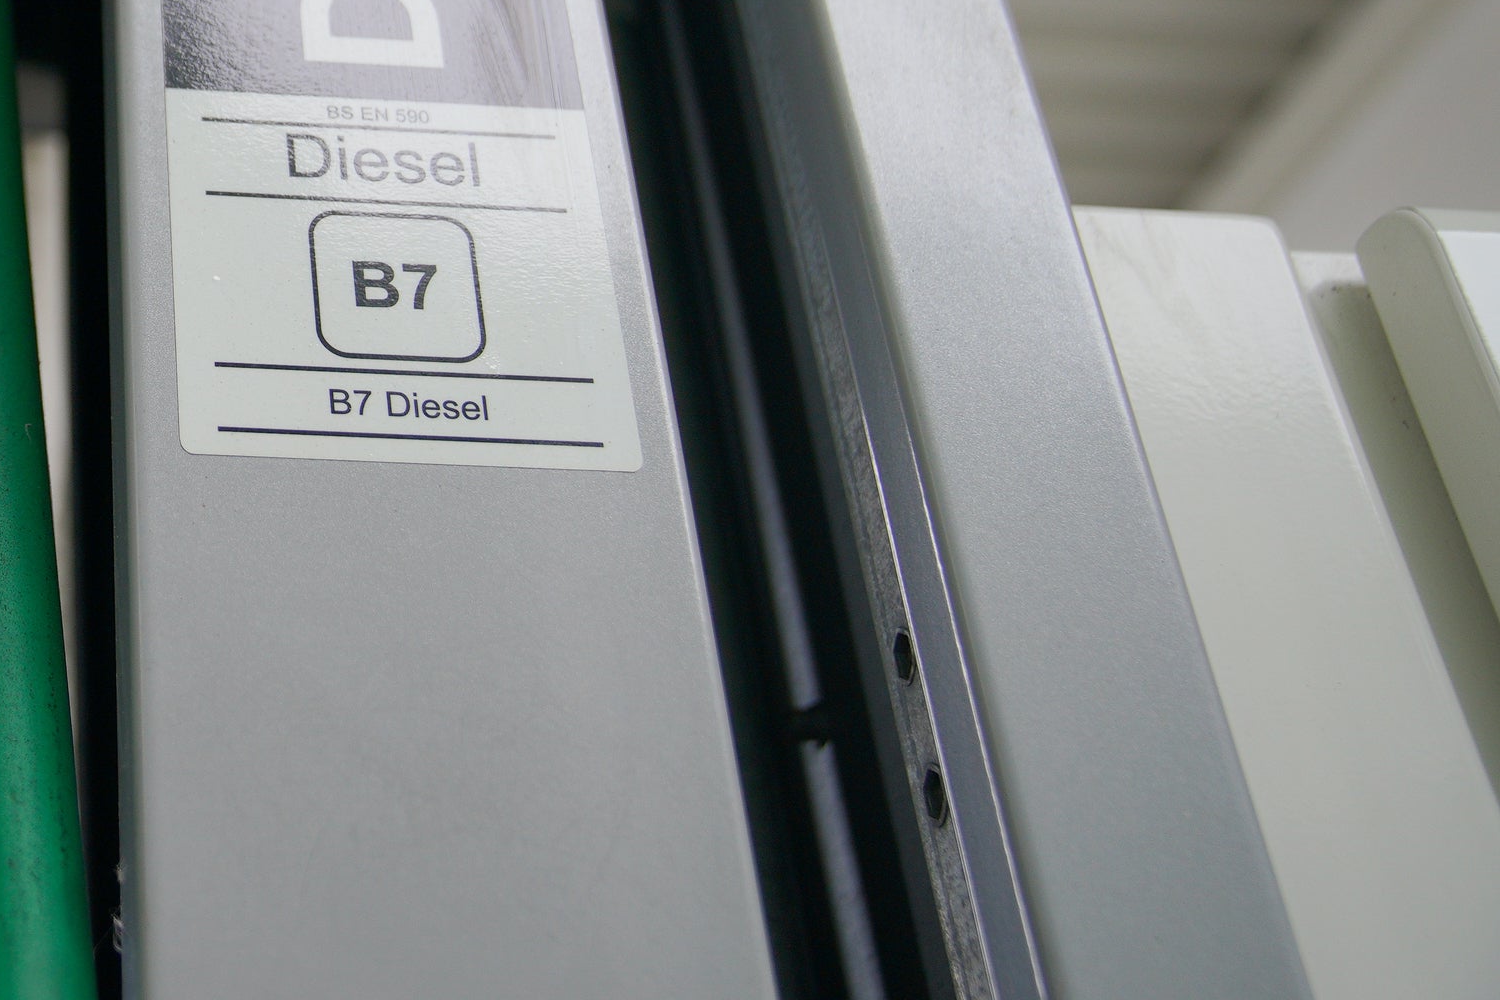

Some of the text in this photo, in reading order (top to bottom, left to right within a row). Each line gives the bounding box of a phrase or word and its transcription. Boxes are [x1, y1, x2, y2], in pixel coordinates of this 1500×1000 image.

[325, 104, 430, 124] BS EN 590
[285, 132, 481, 188] Diesel
[351, 260, 438, 311] B7
[328, 388, 490, 421] B7 Diesel
